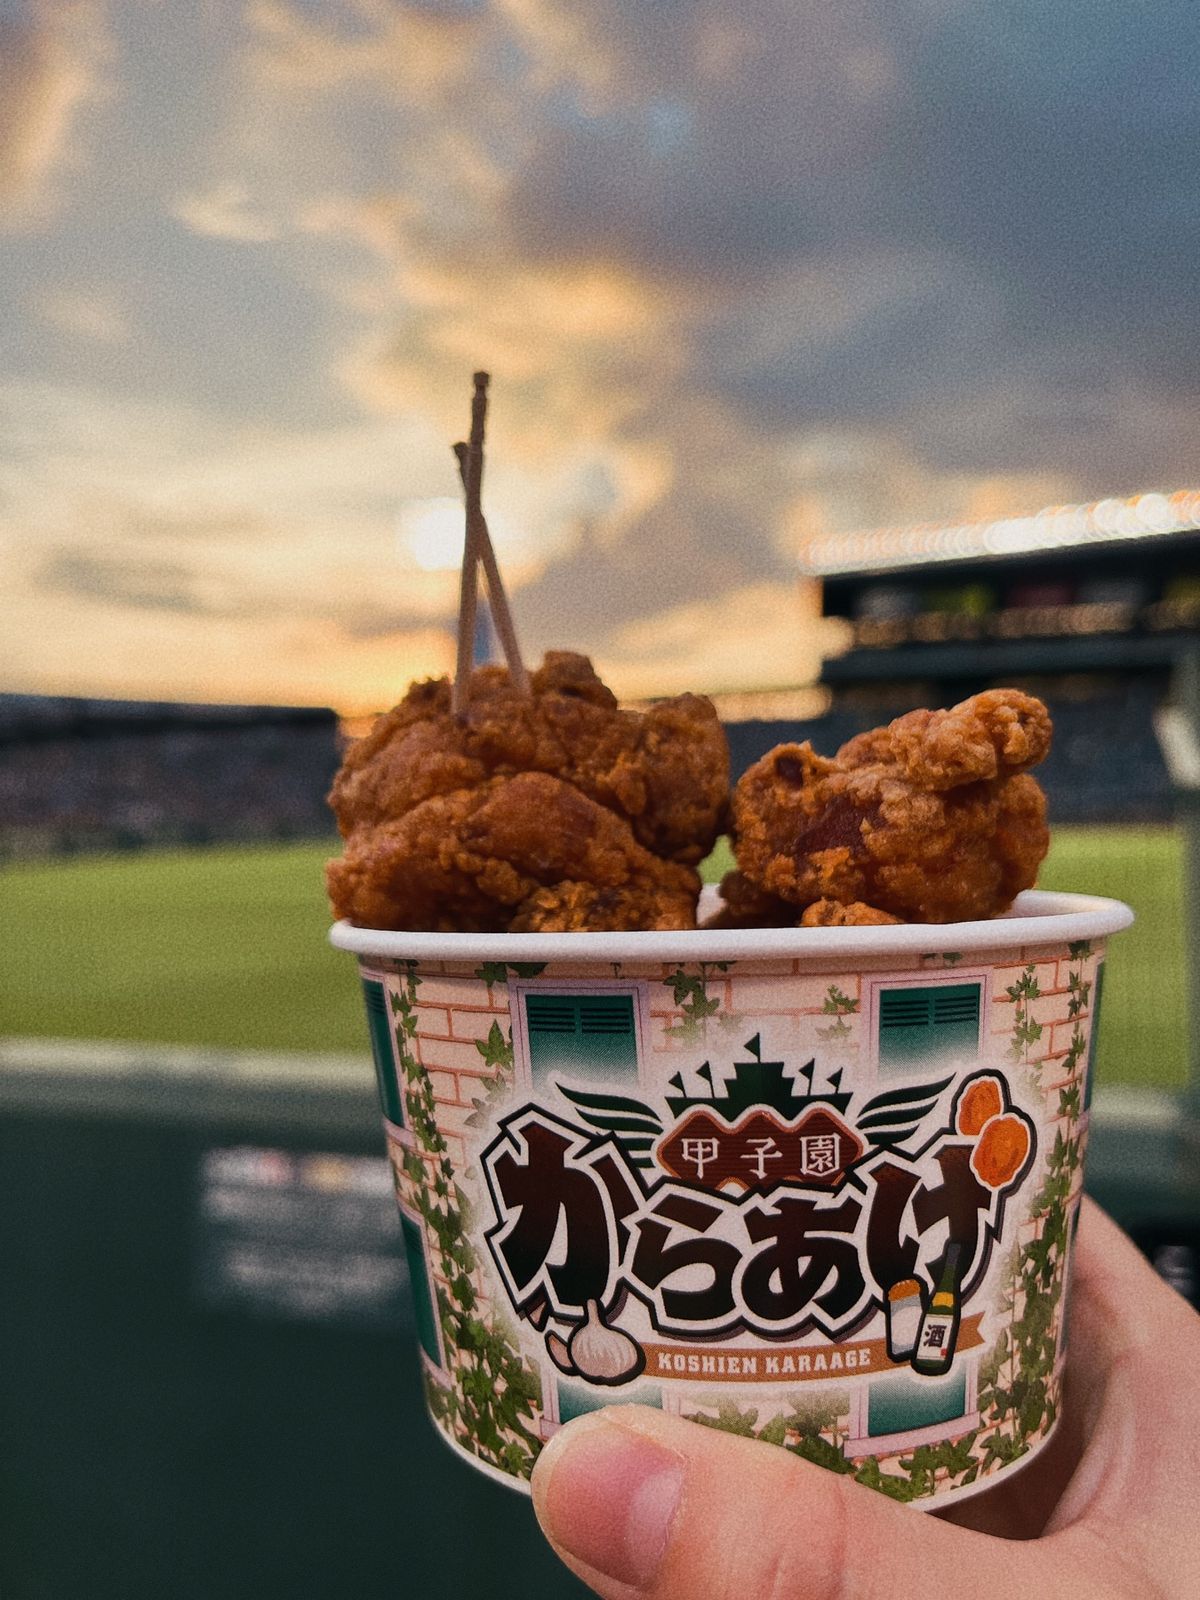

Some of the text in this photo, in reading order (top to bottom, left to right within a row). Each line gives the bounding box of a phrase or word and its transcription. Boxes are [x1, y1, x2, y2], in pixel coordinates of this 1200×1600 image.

[681, 1132, 841, 1179] 甲子園
[492, 1076, 1032, 1324] からあげ
[923, 1324, 947, 1348] 酒
[658, 1348, 872, 1374] KOSHIEN KARAAGE
